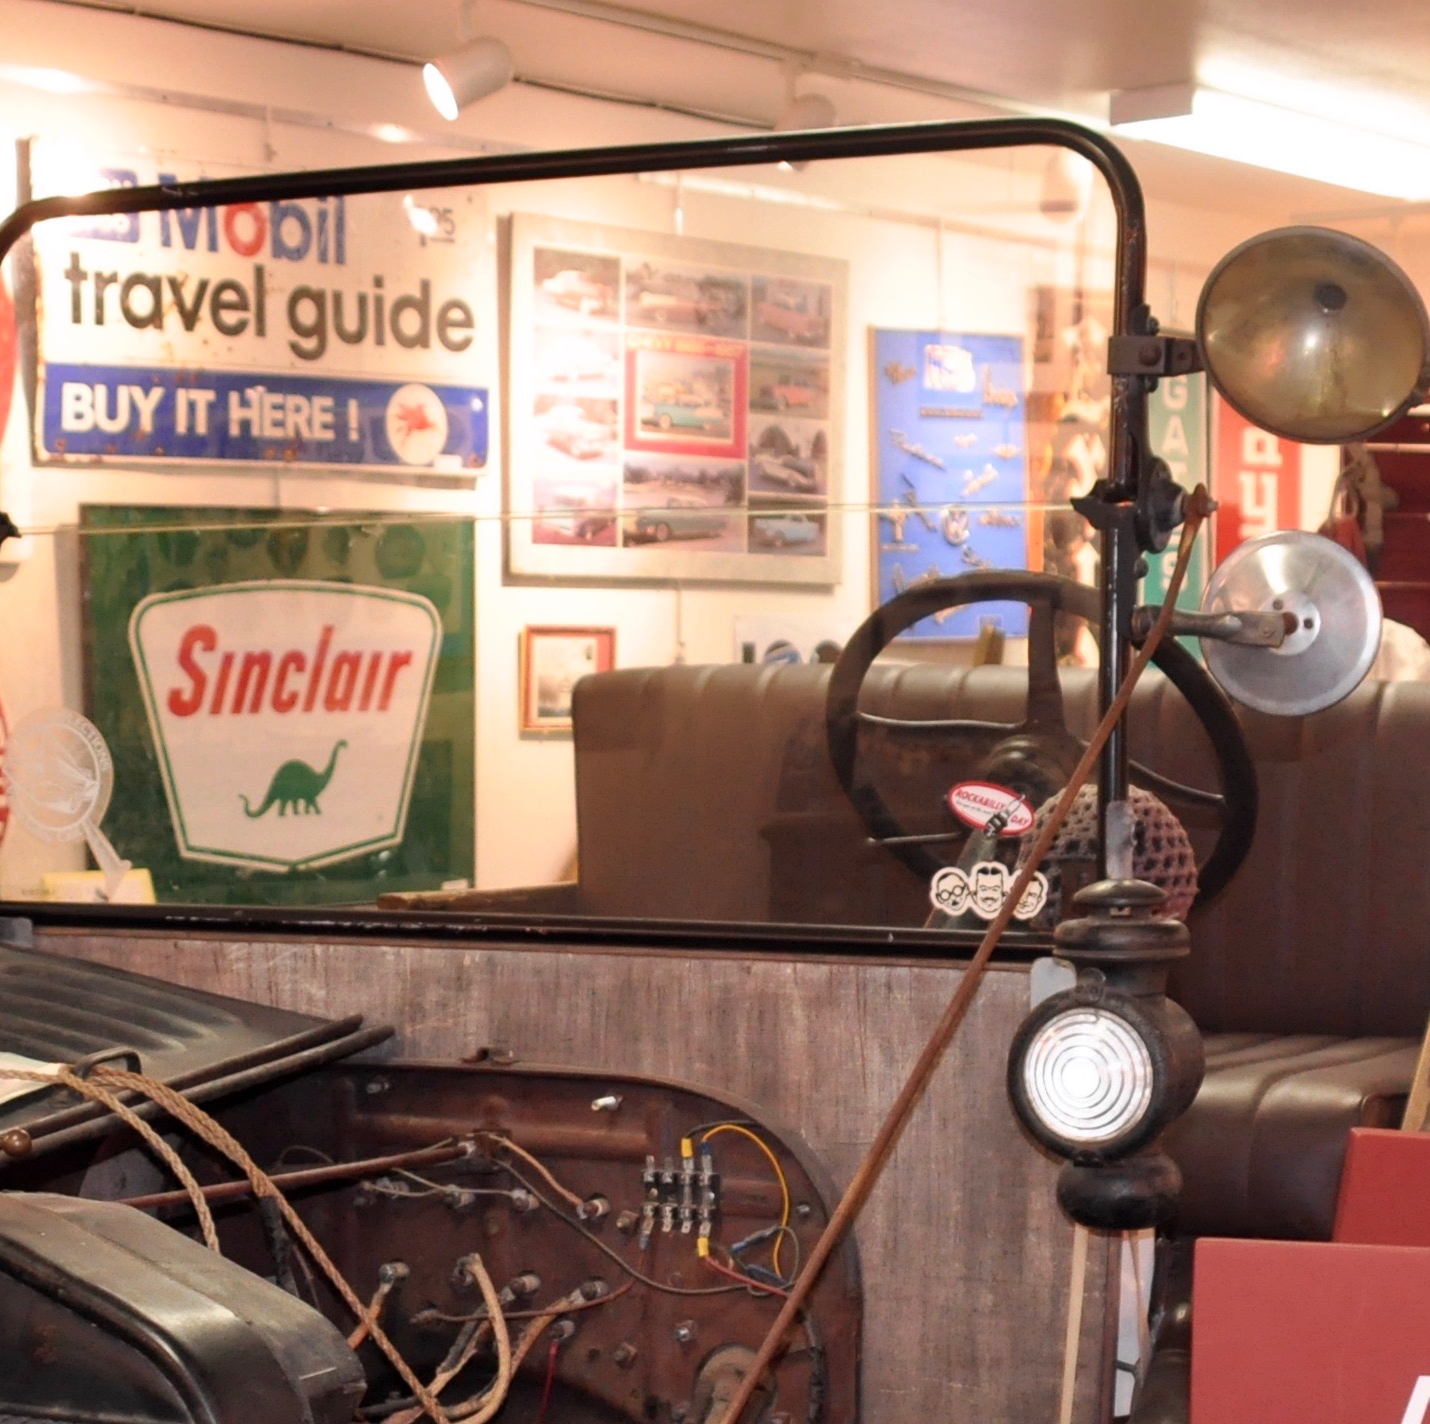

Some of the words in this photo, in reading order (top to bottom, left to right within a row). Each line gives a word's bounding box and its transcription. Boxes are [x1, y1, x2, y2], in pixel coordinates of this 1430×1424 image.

[159, 175, 347, 266] Mobil
[64, 251, 266, 338] travel
[286, 275, 476, 361] guide
[61, 382, 166, 435] BUY
[175, 387, 216, 437] IT
[228, 385, 337, 442] HERE
[167, 623, 414, 718] Sinclair
[1011, 814, 1030, 827] DAY
